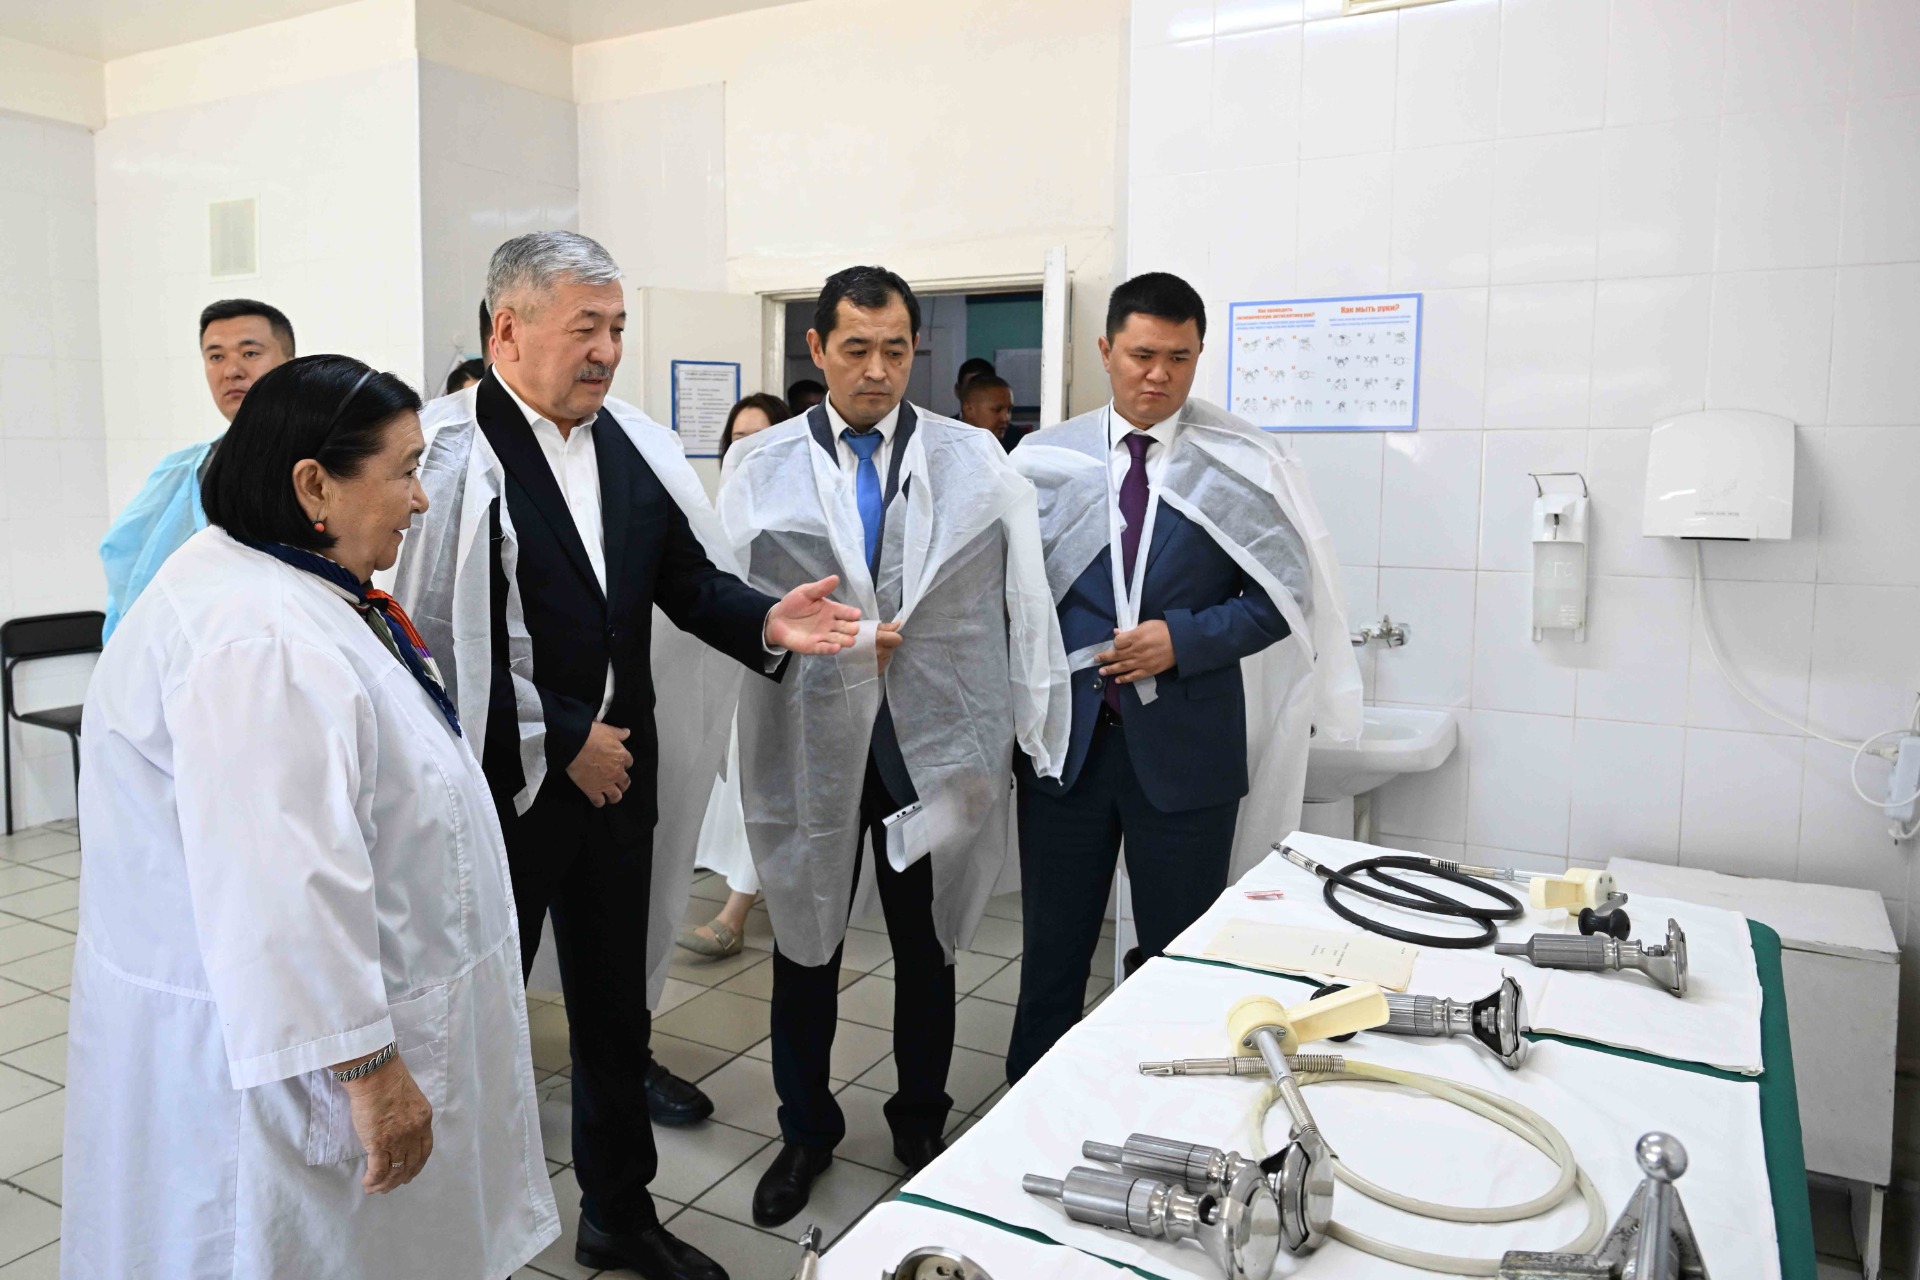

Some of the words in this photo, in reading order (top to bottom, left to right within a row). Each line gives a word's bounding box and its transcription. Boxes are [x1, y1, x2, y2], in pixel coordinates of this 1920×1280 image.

[1340, 306, 1354, 314] Как
[1355, 305, 1376, 313] мыть
[1377, 303, 1400, 313] руки?
